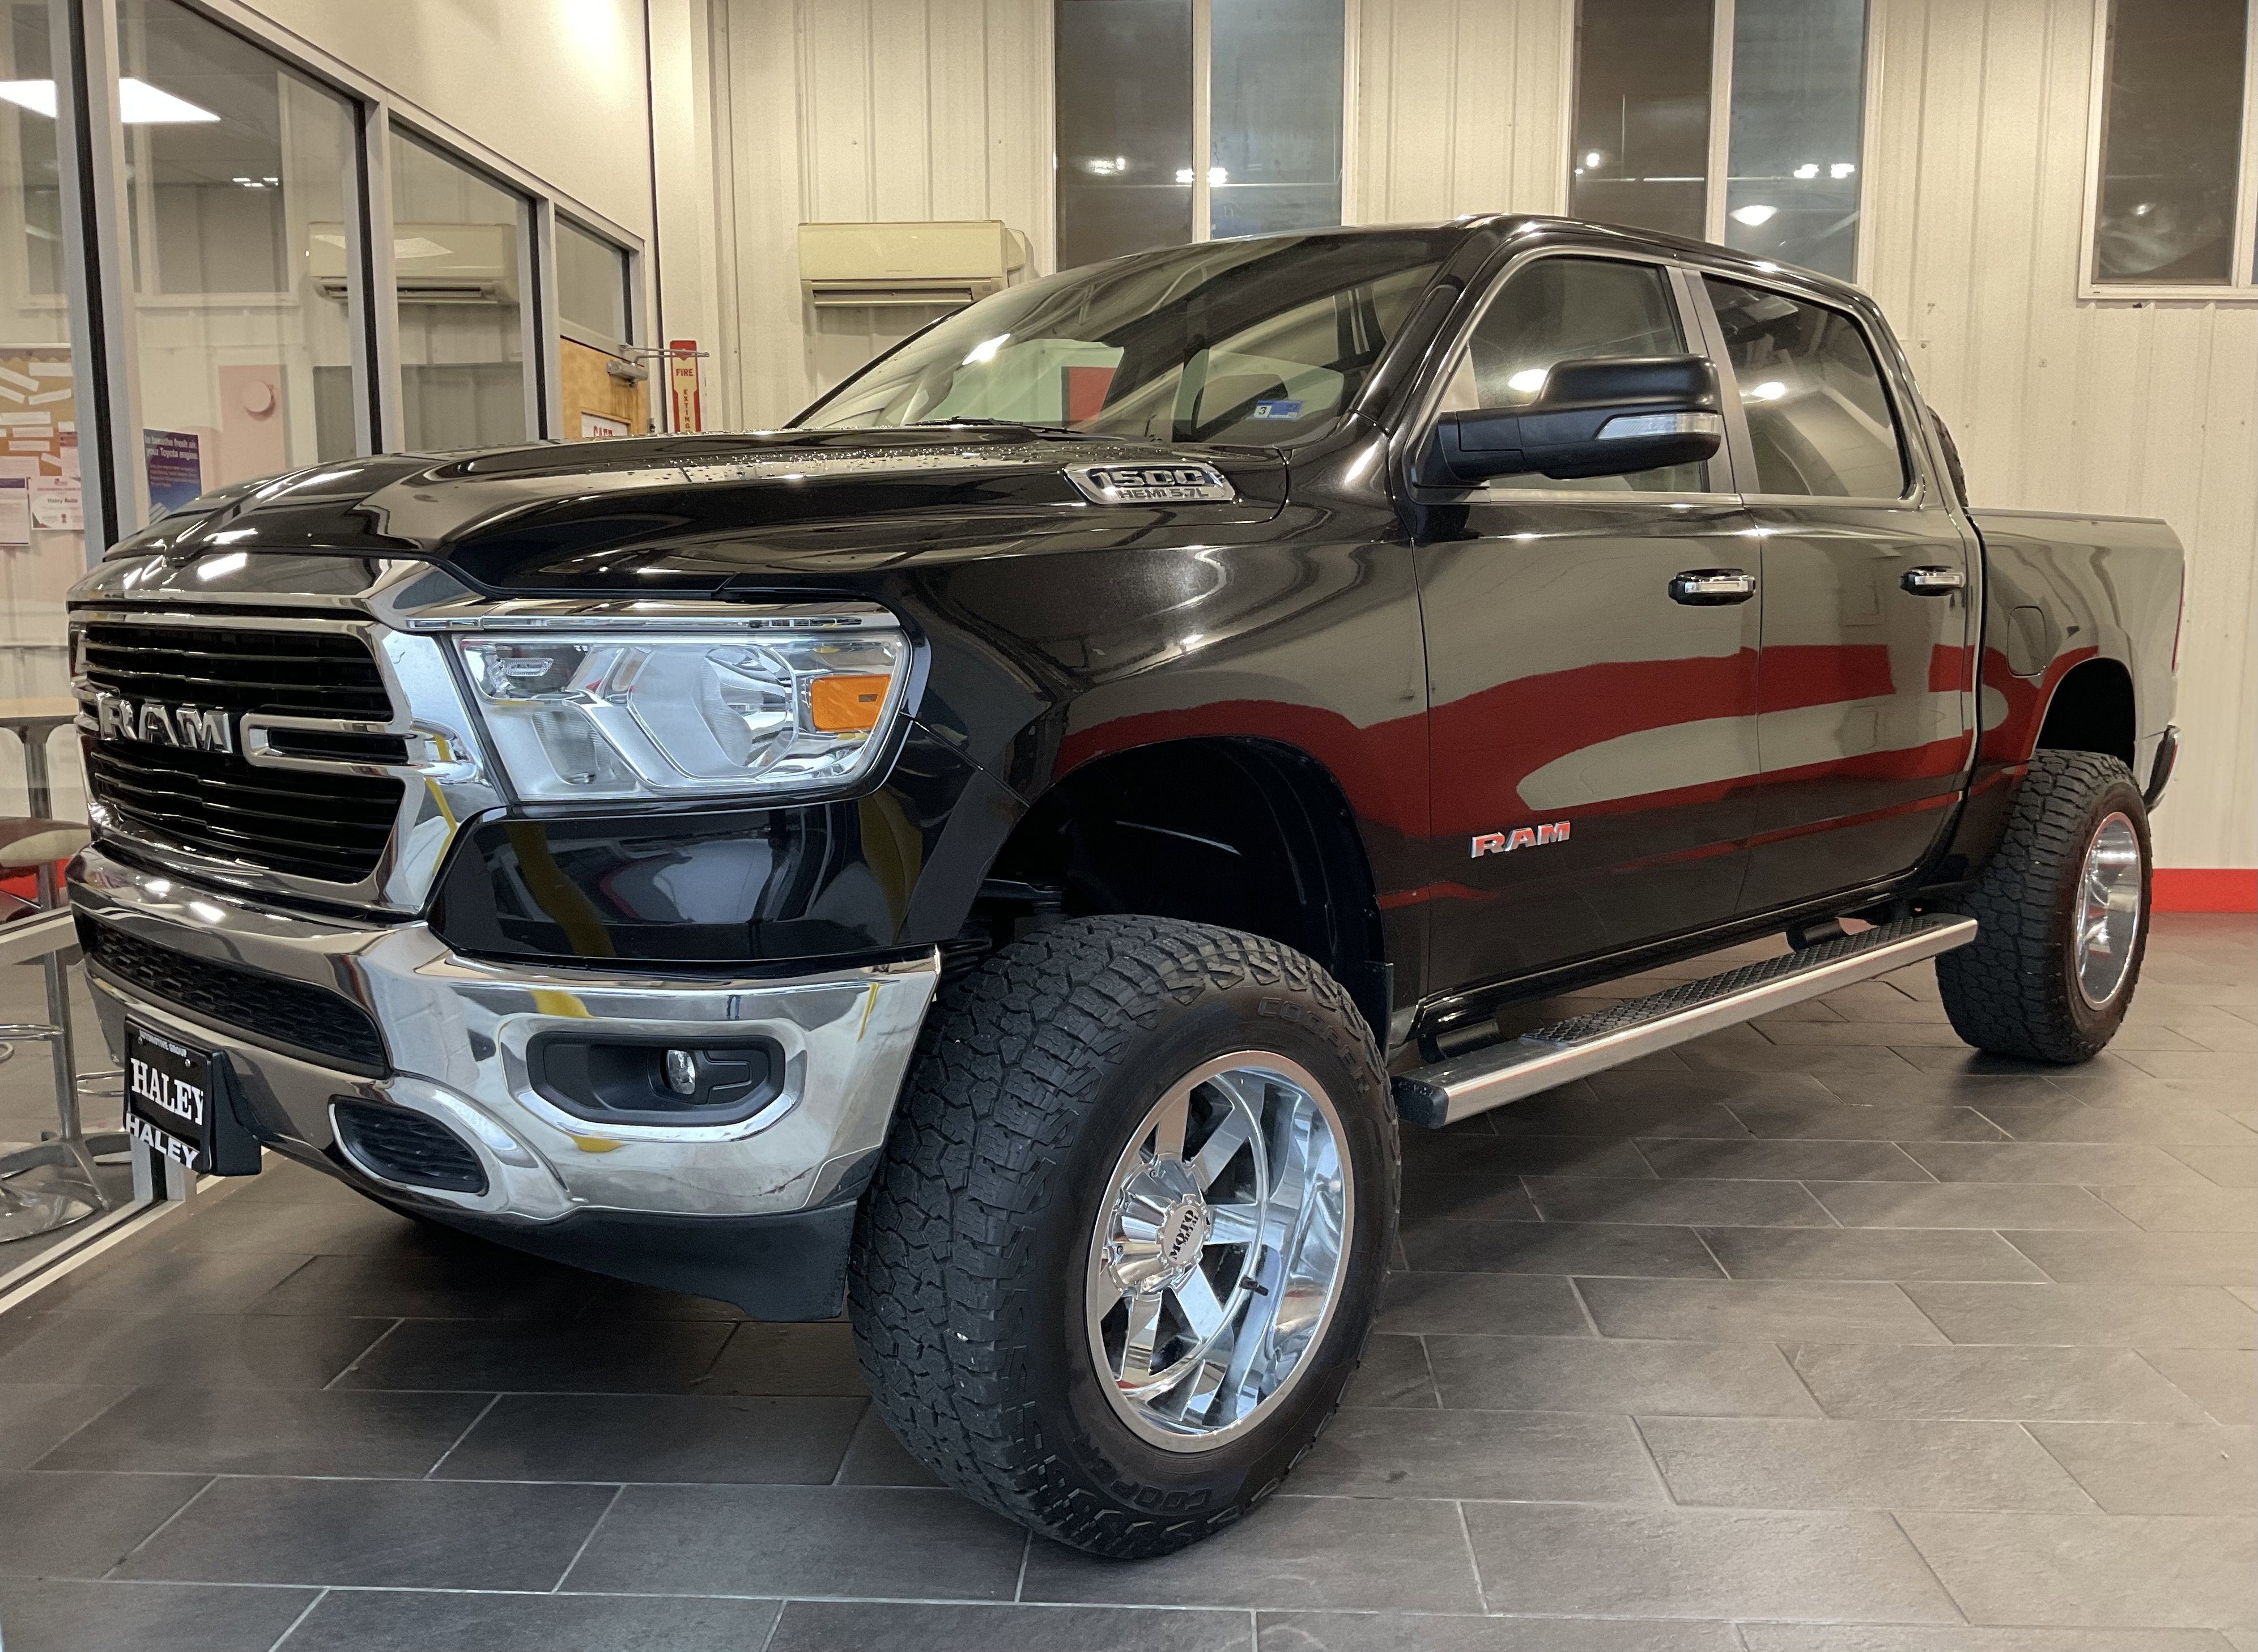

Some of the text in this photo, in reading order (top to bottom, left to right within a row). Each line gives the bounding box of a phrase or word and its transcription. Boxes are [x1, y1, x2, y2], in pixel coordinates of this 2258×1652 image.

[1259, 406, 1267, 415] 3
[160, 448, 178, 458] Toyota
[174, 438, 188, 448] fresh
[1091, 470, 1206, 487] 1500
[1116, 487, 1210, 499] HEMI 5.7L
[97, 692, 233, 753] RAM
[1471, 820, 1571, 858] RAM
[130, 1058, 203, 1126] HALEY
[126, 1113, 198, 1169] HALEY
[1169, 1210, 1194, 1261] MOTO
